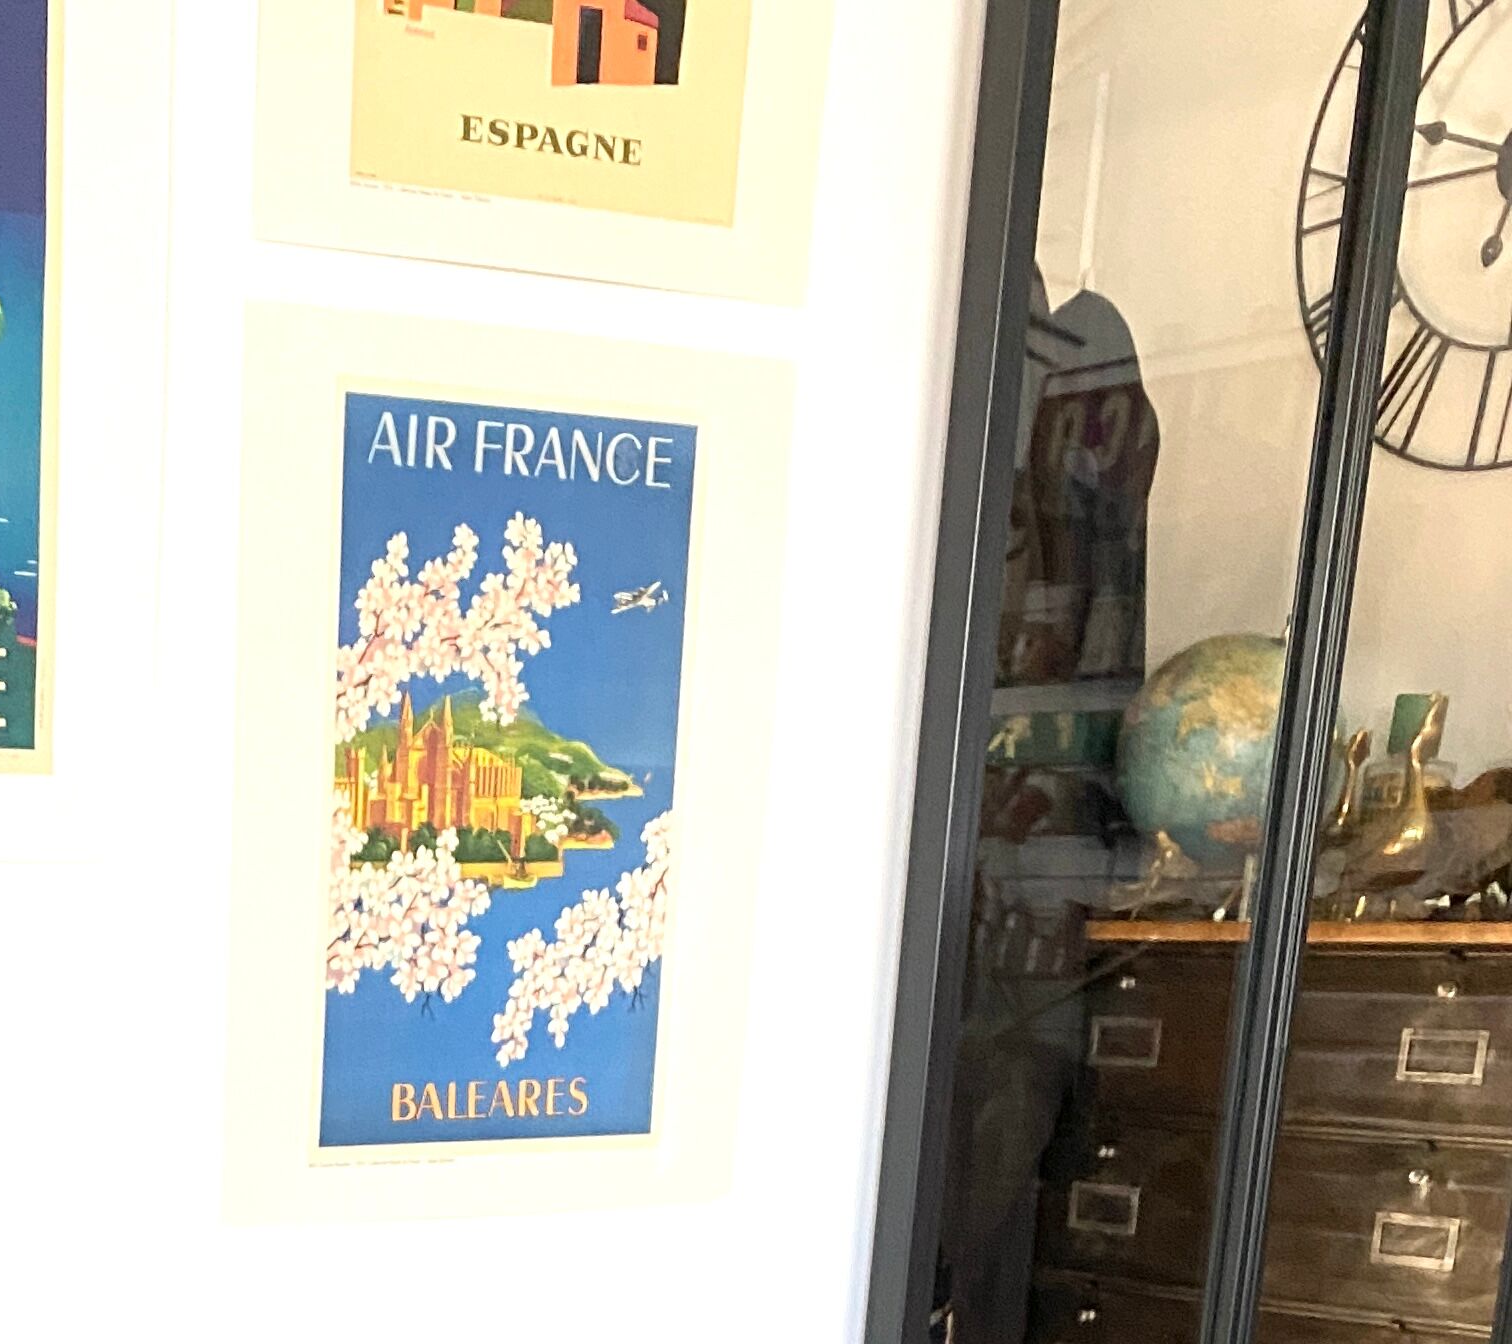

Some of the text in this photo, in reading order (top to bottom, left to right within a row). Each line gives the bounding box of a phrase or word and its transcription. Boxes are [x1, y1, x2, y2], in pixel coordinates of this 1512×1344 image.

[459, 113, 644, 167] ESPAGNE
[367, 411, 675, 489] AIR FRANCE
[390, 1076, 591, 1122] BALEARES
